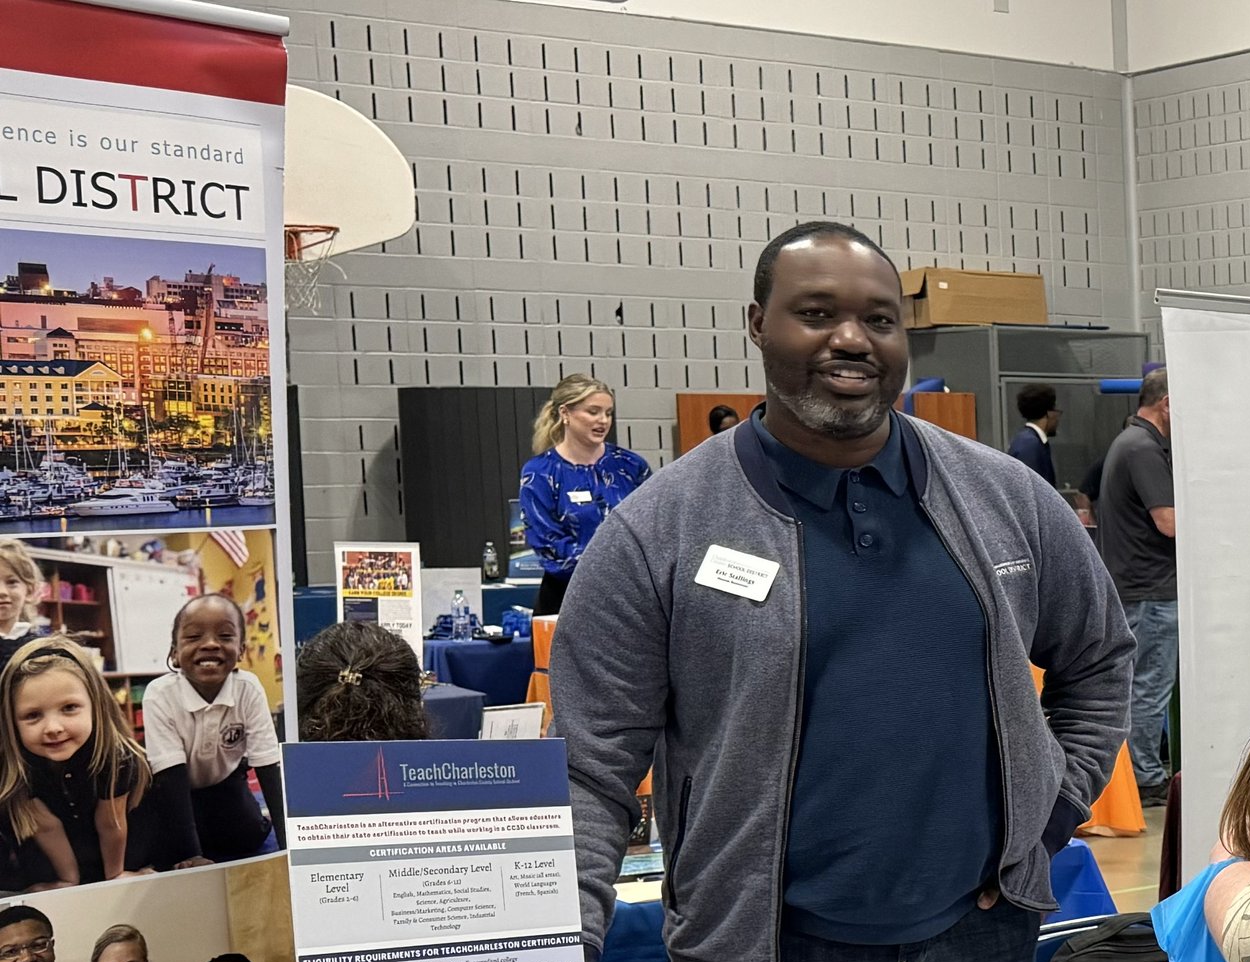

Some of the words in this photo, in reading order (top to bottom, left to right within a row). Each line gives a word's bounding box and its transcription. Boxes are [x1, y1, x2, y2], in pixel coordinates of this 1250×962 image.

[69, 129, 88, 148] is
[99, 136, 139, 154] our
[151, 139, 244, 165] standard
[36, 165, 250, 221] DISTRICT
[399, 761, 516, 783] TeachCharleston
[369, 846, 434, 857] CERTIFICATION
[435, 844, 462, 853] AREAS
[463, 842, 506, 851] AVAILABLE
[388, 864, 468, 877] Middle/Secondary
[470, 862, 492, 873] Level
[514, 861, 532, 870] K-12
[534, 858, 555, 869] Level
[310, 872, 364, 882] Elementary
[325, 882, 349, 893] Level
[430, 923, 461, 931] Technology
[354, 949, 420, 962] REQUIREMENTS
[422, 947, 439, 956] FOR
[440, 941, 520, 954] TEACHCHARLESTON
[521, 935, 580, 947] CERTIFICATION
